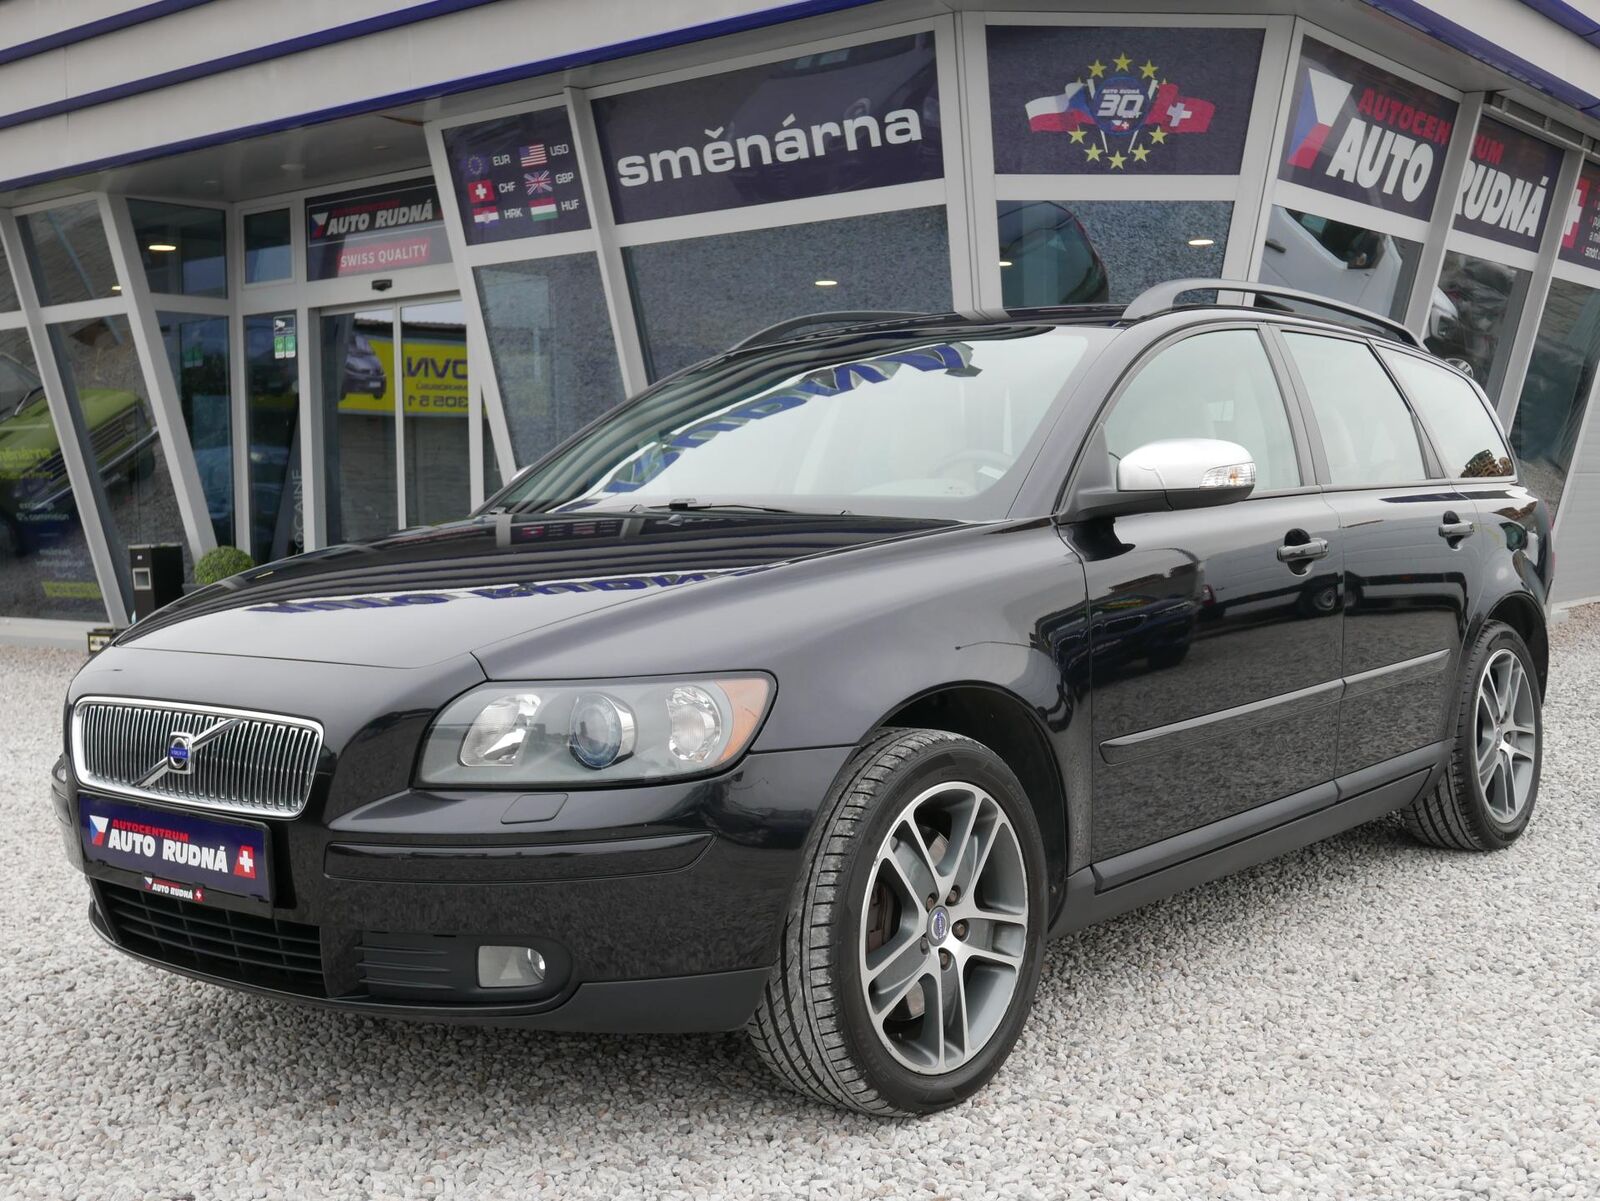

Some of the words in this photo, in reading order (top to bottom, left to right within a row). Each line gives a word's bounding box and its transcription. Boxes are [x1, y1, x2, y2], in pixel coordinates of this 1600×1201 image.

[1097, 94, 1145, 117] 30
[549, 144, 569, 156] USD
[617, 107, 922, 187] směnárna
[1472, 133, 1504, 166] UM
[492, 155, 511, 166] EUR
[1325, 117, 1434, 202] AUTO
[498, 182, 516, 193] CHF
[555, 172, 574, 184] GBP
[326, 213, 370, 235] AUTO
[375, 198, 433, 229] RUDNÁ
[504, 208, 523, 219] HRK
[560, 199, 580, 211] HUF
[340, 252, 376, 268] SWISS
[378, 244, 428, 263] QUALITY
[112, 818, 190, 843] AUTOCENTRUM
[108, 828, 156, 857] AUTO
[162, 845, 228, 873] RUDNÁ
[152, 883, 170, 894] AUTO
[170, 887, 193, 900] RUDNÁ
